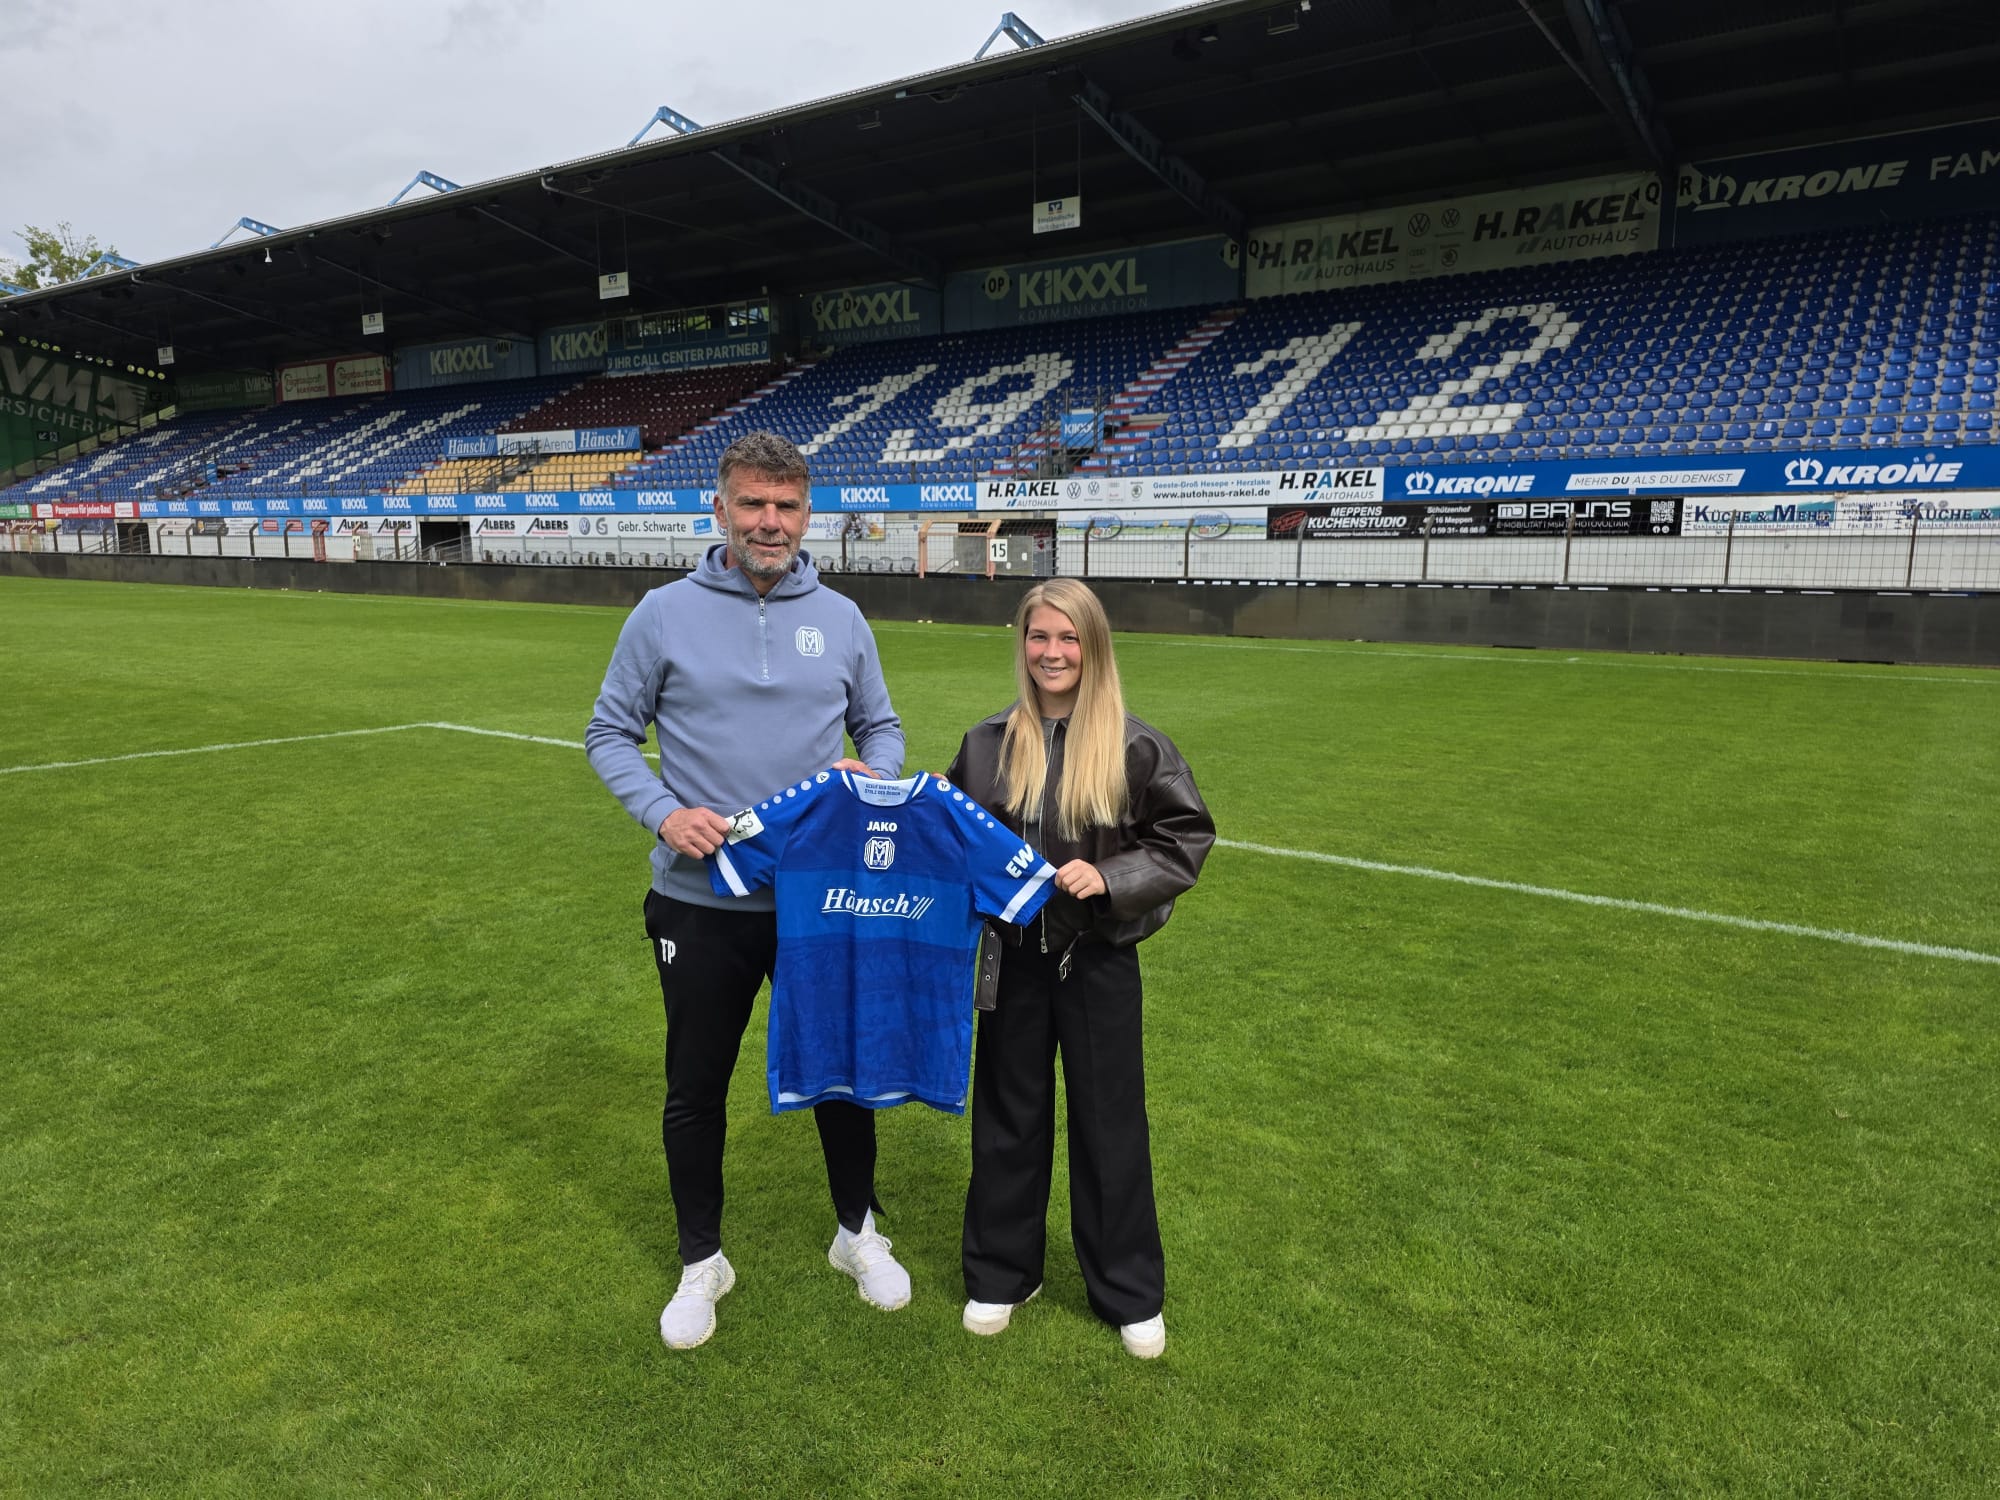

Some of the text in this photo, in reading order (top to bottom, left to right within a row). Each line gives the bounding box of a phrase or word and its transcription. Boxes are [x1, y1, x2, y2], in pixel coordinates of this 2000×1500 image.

[1737, 160, 1909, 206] KRONE
[1473, 192, 1646, 242] H.RAKEL
[1258, 227, 1399, 269] H.RAKEL
[1541, 227, 1640, 252] AUTOHAUS
[1314, 257, 1395, 281] AUTOHAUS
[1018, 297, 1149, 321] KOMMUNIKATION
[614, 356, 631, 368] IHR
[633, 353, 660, 367] CALL
[662, 347, 705, 364] CENTER
[706, 342, 759, 361] PARTNER
[448, 438, 488, 454] Hänsch
[543, 437, 573, 450] Arena
[580, 430, 626, 449] Hänsch
[1279, 470, 1377, 490] H.RAKEL
[1575, 473, 1734, 486] MEHR DU ALS DU DENKST.
[1823, 461, 1963, 485] KRONE
[988, 482, 1060, 498] H.RAKEL
[1200, 480, 1229, 490] Hesepe
[1236, 478, 1270, 487] Herzlake
[1434, 474, 1536, 495] KRONE
[1153, 488, 1270, 499] www.autohaus-rakel.de
[1318, 490, 1375, 501] AUTOHAUS
[1016, 499, 1059, 508] AUTOHAUS
[1330, 506, 1383, 517] MEPPENS
[1530, 502, 1632, 519] BRUNS
[1757, 511, 1769, 523] &
[1773, 504, 1831, 523] MEH
[476, 517, 516, 534] ALBERS
[525, 517, 569, 534] ALBERS
[617, 520, 641, 532] Gebr.
[643, 519, 687, 532] Schwarte
[1571, 520, 1630, 528] HOTOVOLTAIK
[991, 543, 1006, 558] 15
[866, 821, 898, 833] JAKO
[1004, 843, 1035, 879] EW
[822, 887, 910, 915] Hänsch
[659, 937, 677, 965] TP
